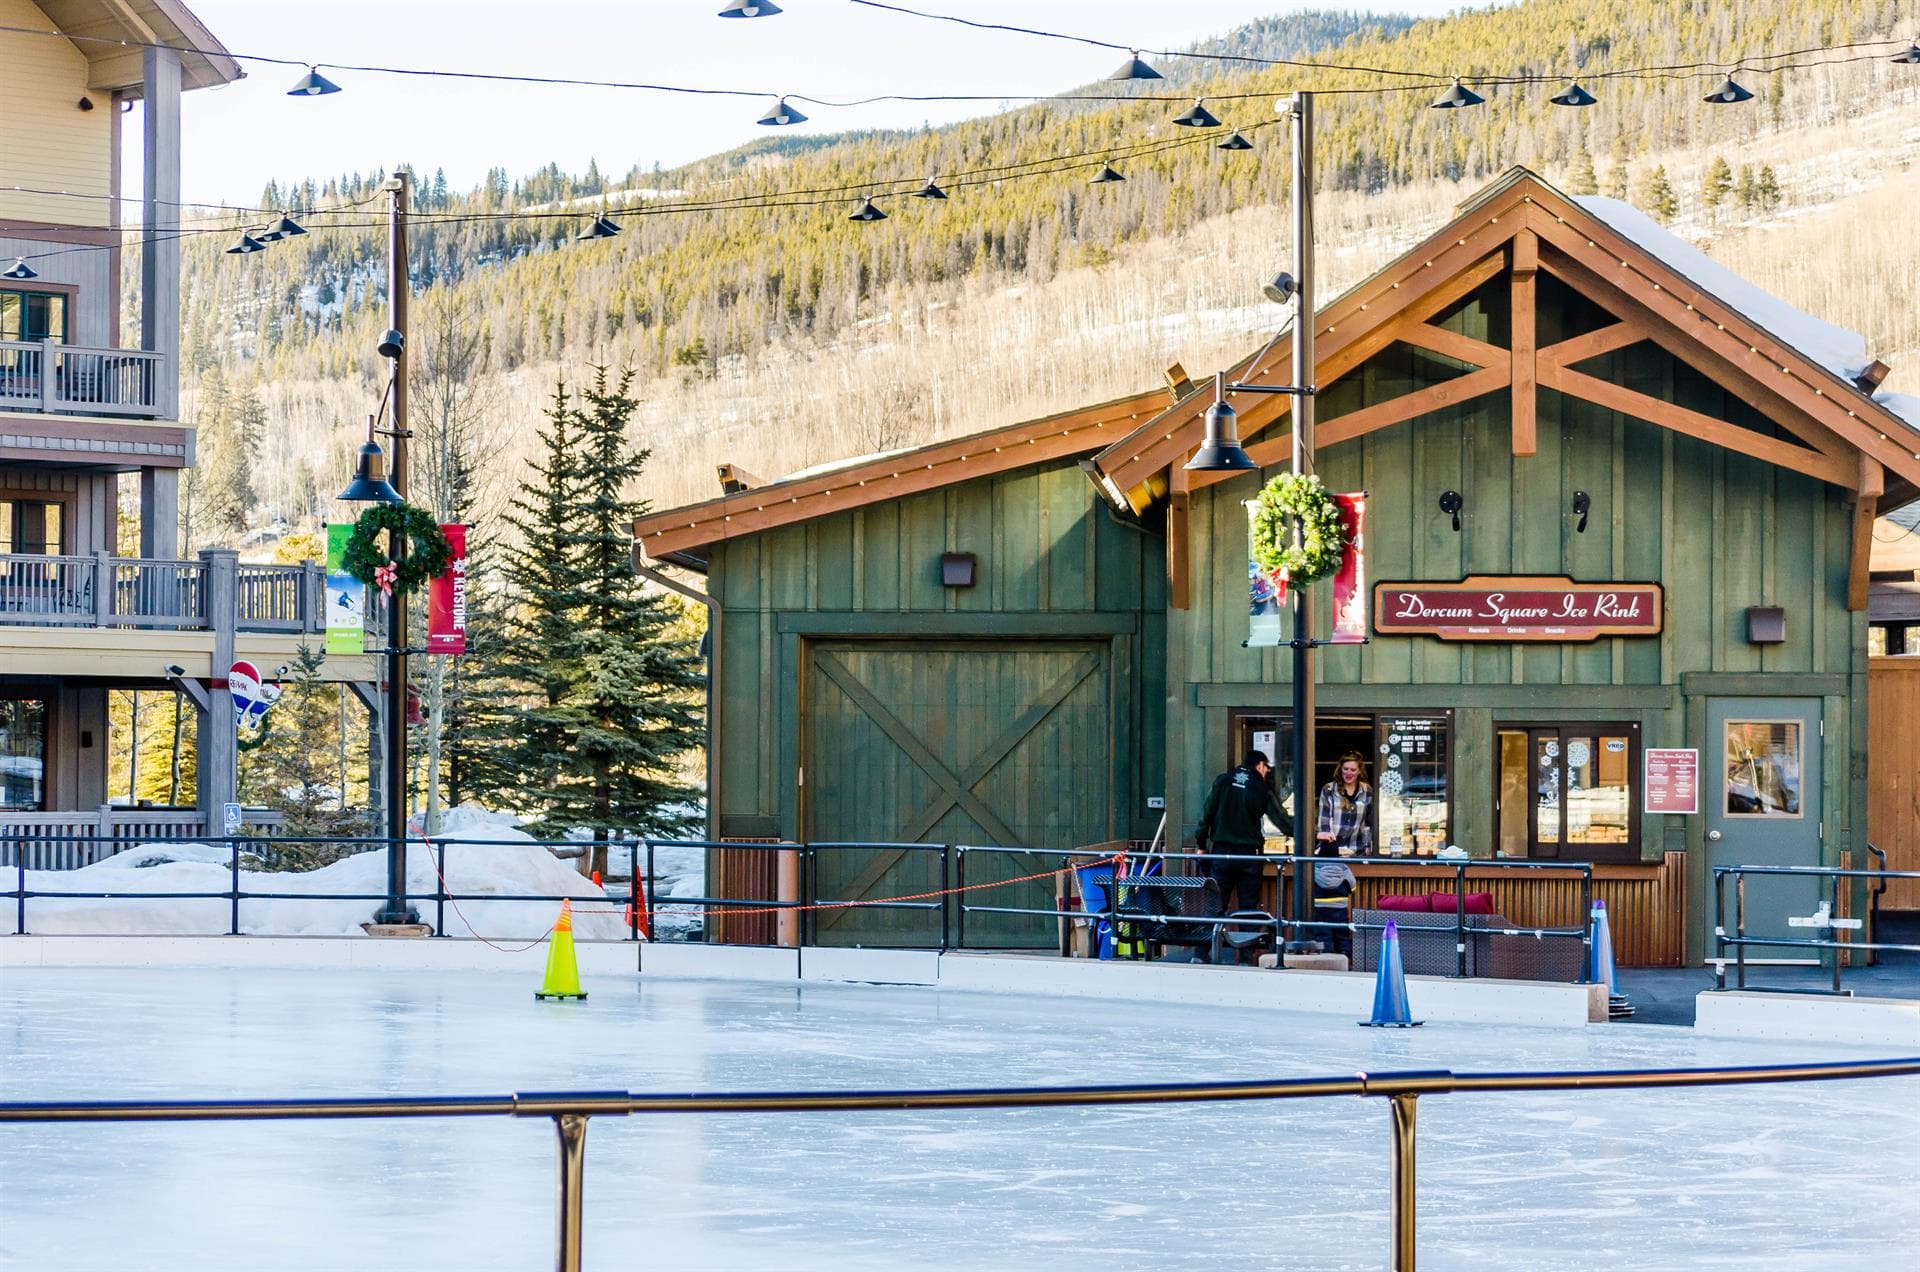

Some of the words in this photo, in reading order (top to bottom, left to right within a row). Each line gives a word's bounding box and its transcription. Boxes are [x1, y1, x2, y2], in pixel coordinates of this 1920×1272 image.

[453, 577, 465, 631] KEYSTONE
[1395, 593, 1473, 618] Dercum
[1478, 593, 1548, 624] Square
[1552, 593, 1587, 618] Ice
[1592, 593, 1640, 618] Rink
